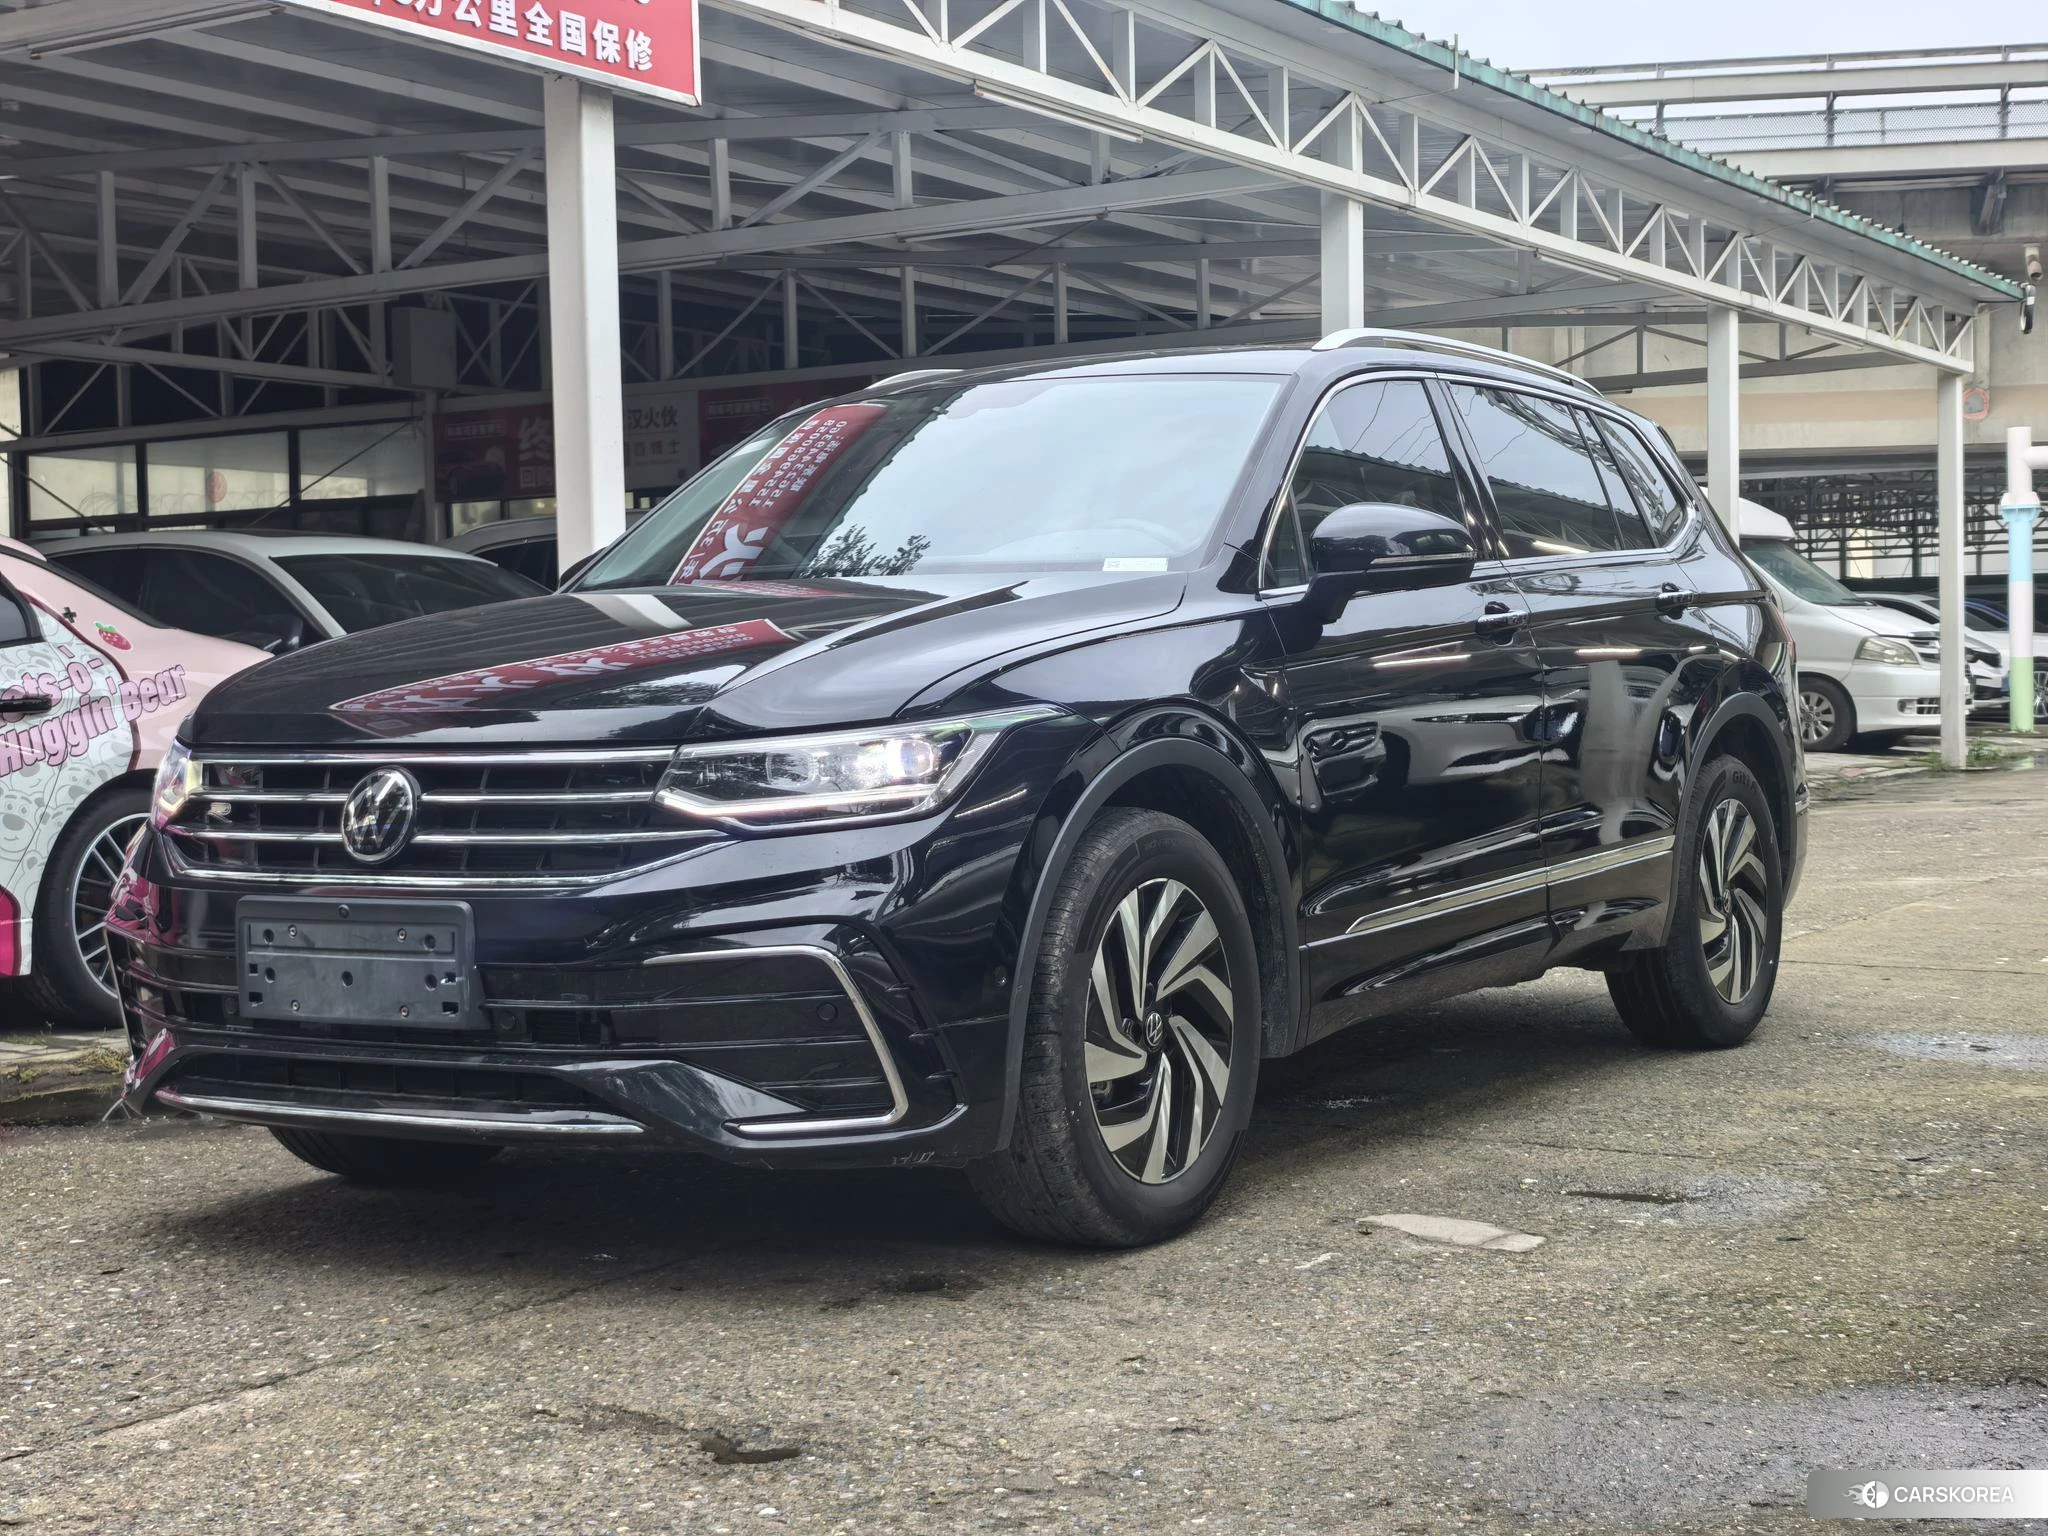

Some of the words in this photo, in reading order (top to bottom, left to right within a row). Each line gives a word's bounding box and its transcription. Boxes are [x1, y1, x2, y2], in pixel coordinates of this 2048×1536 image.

[372, 0, 653, 72] 公里全国保修
[119, 664, 187, 722] Bear
